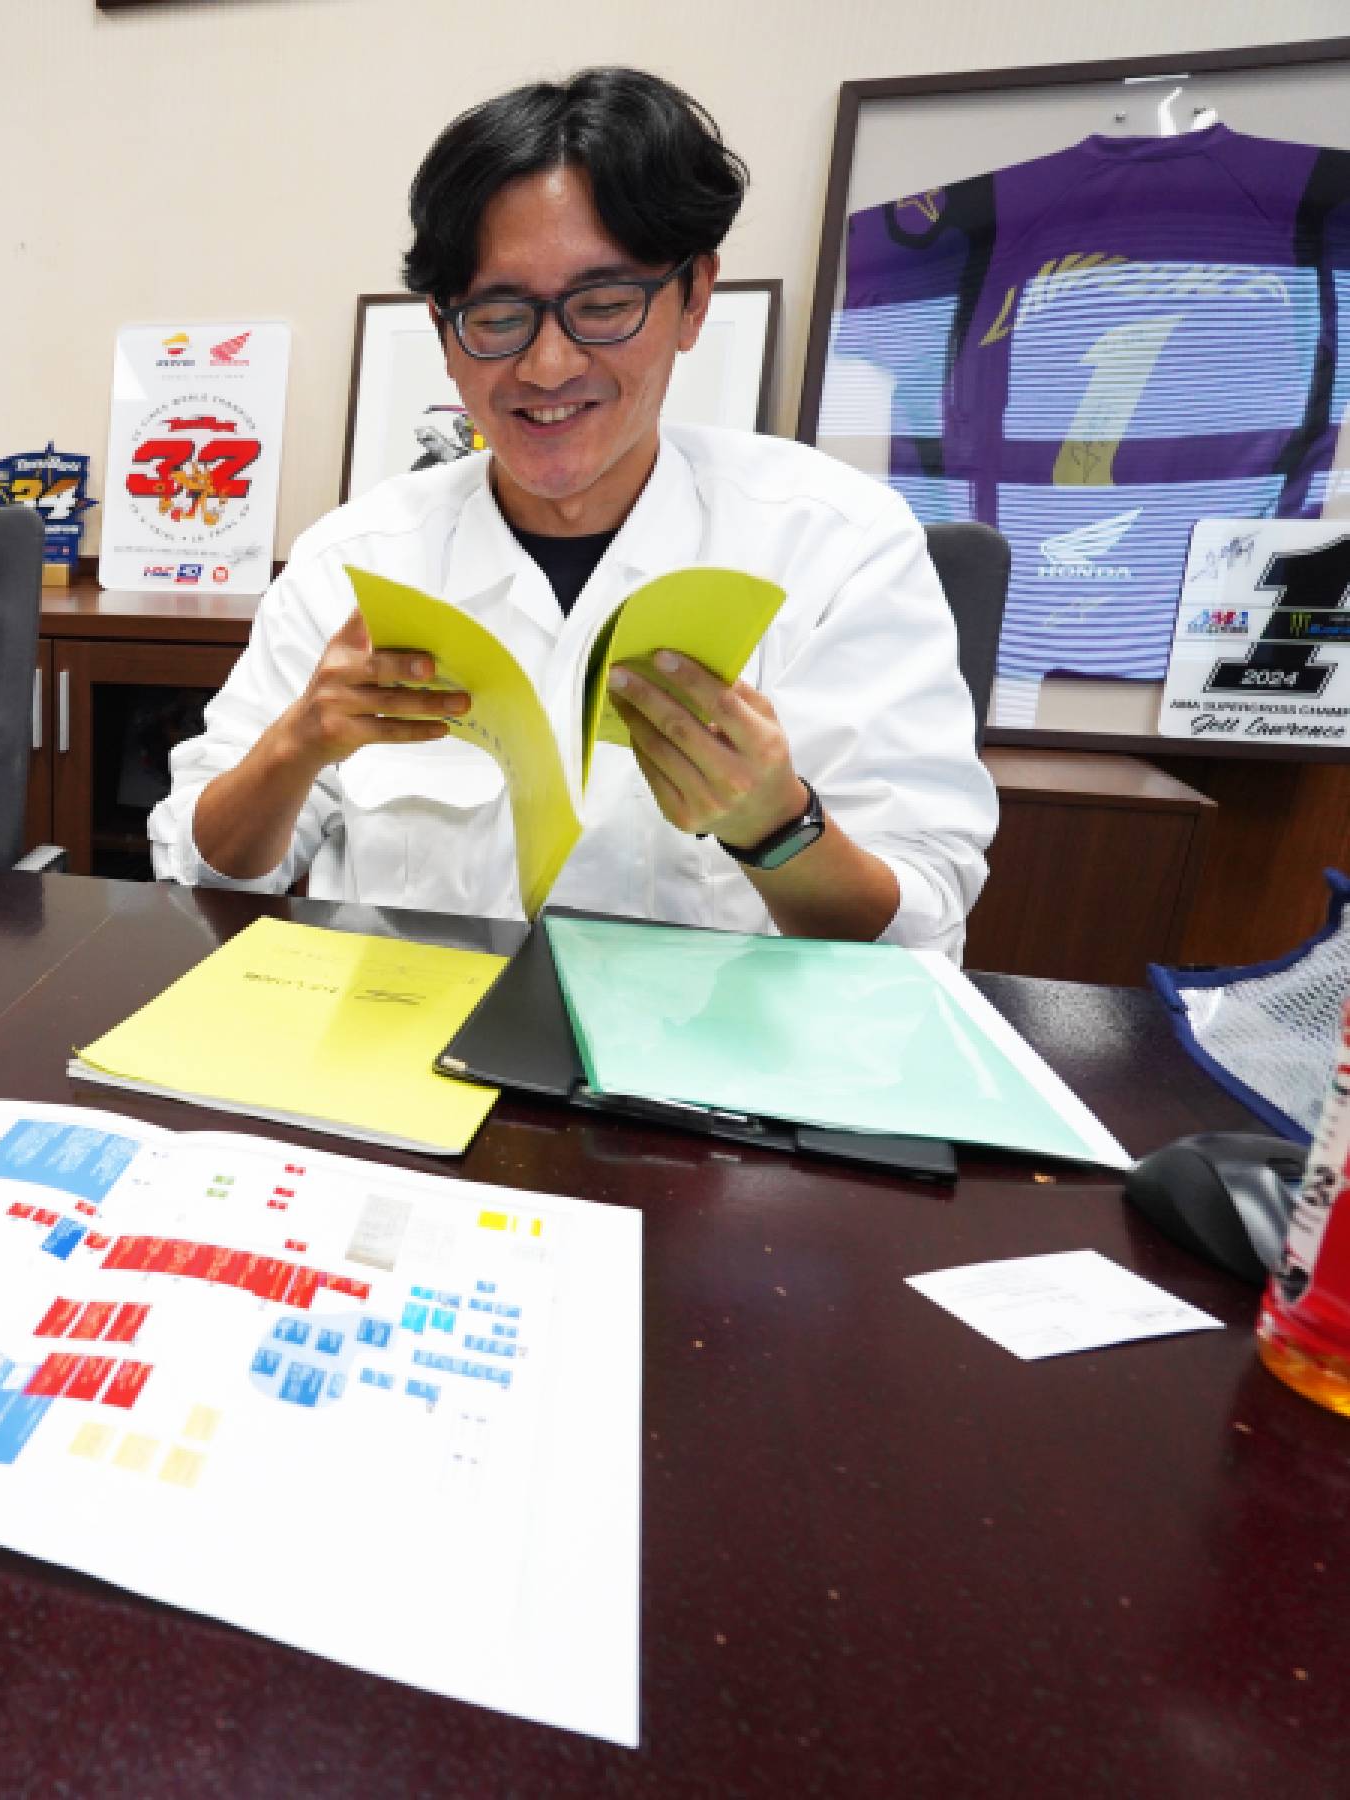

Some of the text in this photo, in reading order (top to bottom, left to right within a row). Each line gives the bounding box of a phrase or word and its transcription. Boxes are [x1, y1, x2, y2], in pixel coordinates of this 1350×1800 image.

[125, 438, 262, 498] 32
[1037, 566, 1132, 578] HONDA
[1240, 669, 1299, 687] 2024
